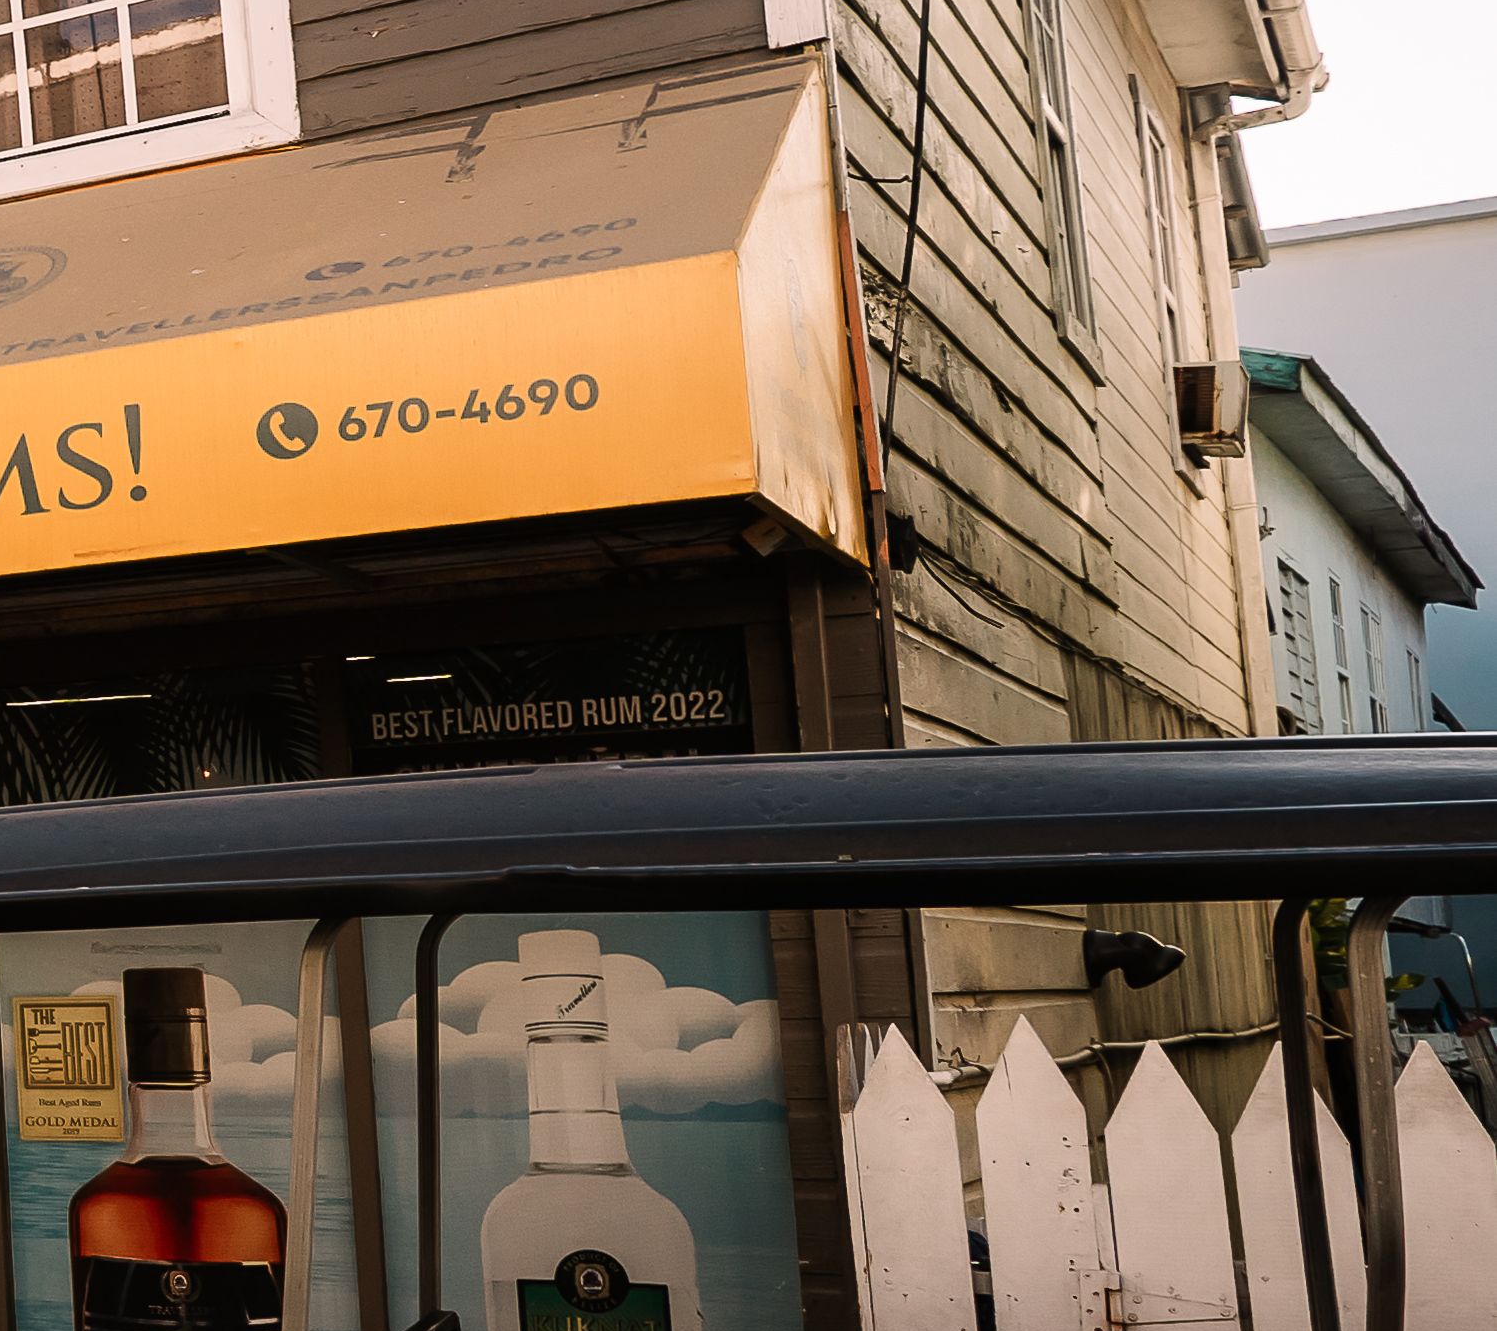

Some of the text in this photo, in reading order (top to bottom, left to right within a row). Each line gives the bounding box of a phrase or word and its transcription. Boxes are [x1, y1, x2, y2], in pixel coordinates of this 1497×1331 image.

[381, 217, 639, 268] 670-4690
[337, 373, 601, 443] 670-4690
[371, 689, 725, 740] BEST FLAVORED RUM 2022
[31, 1009, 56, 1024] THE
[61, 1022, 107, 1085] BEST
[25, 1116, 119, 1127] GOLD MEDAL
[39, 1098, 102, 1108] Best Aged Rum
